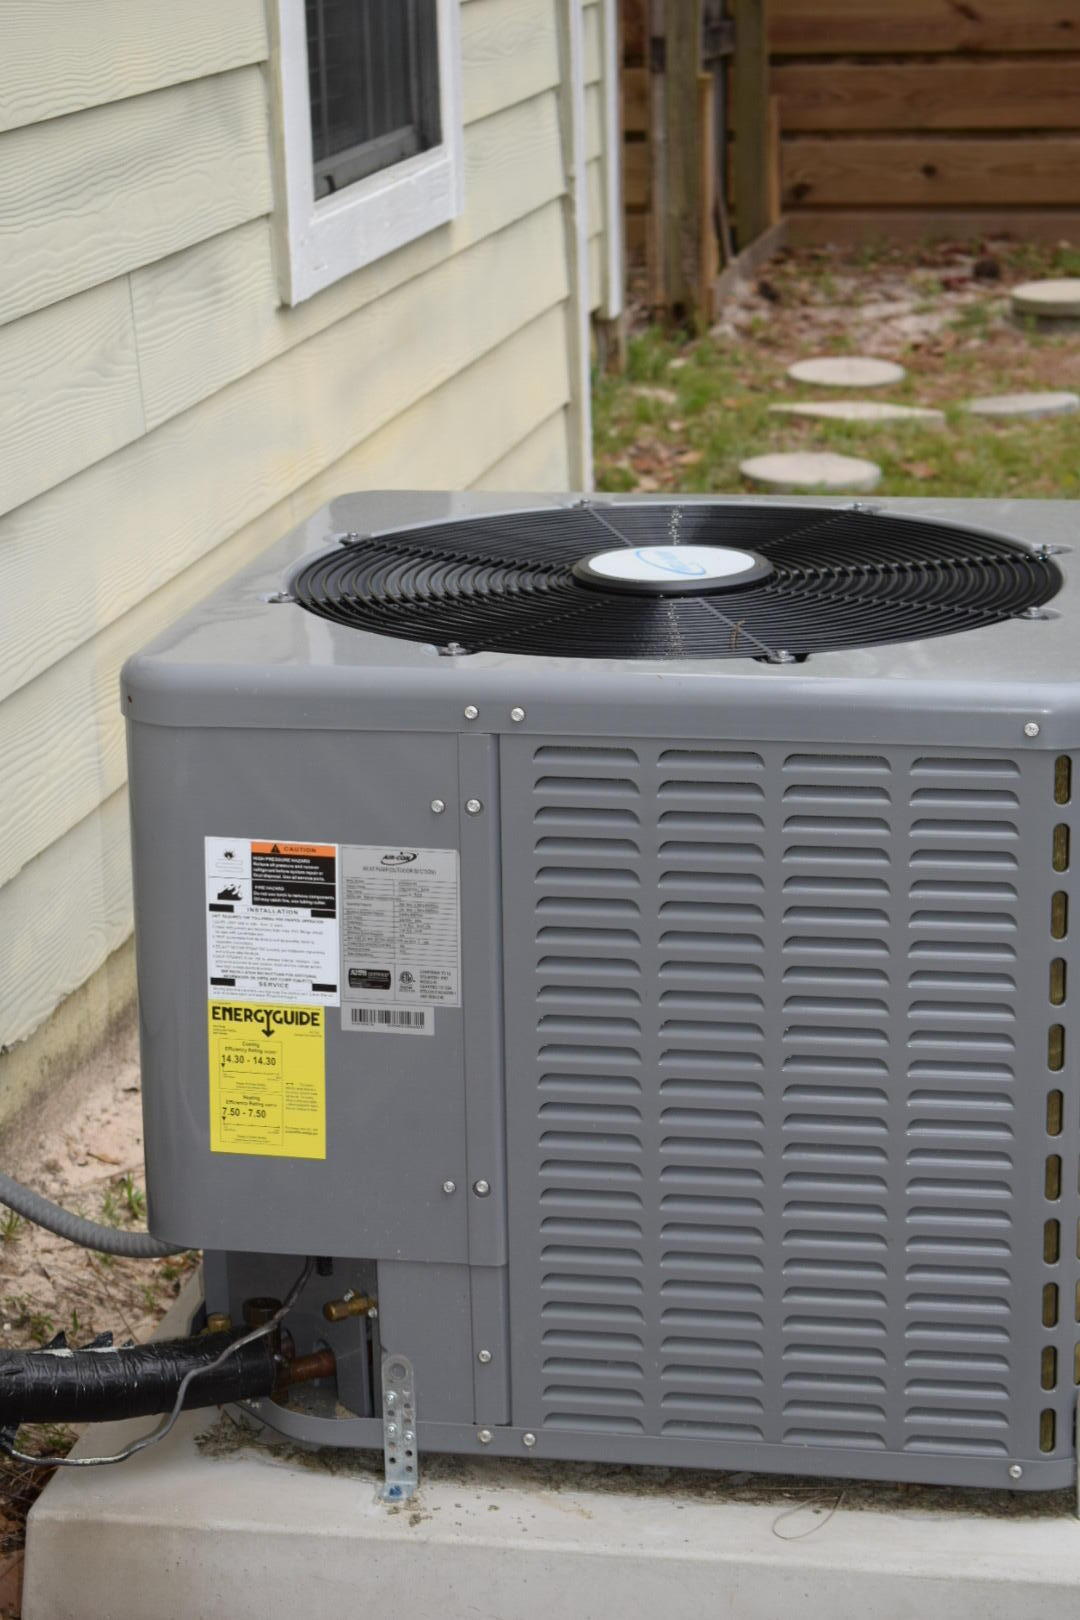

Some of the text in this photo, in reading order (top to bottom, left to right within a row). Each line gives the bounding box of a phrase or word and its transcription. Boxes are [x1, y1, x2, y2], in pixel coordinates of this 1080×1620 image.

[212, 1006, 320, 1028] ENERGYGUIDE
[222, 1054, 244, 1064] 14.30
[253, 1056, 276, 1065] 14.30
[222, 1107, 240, 1116] 7.50
[248, 1109, 266, 1118] 7.50
